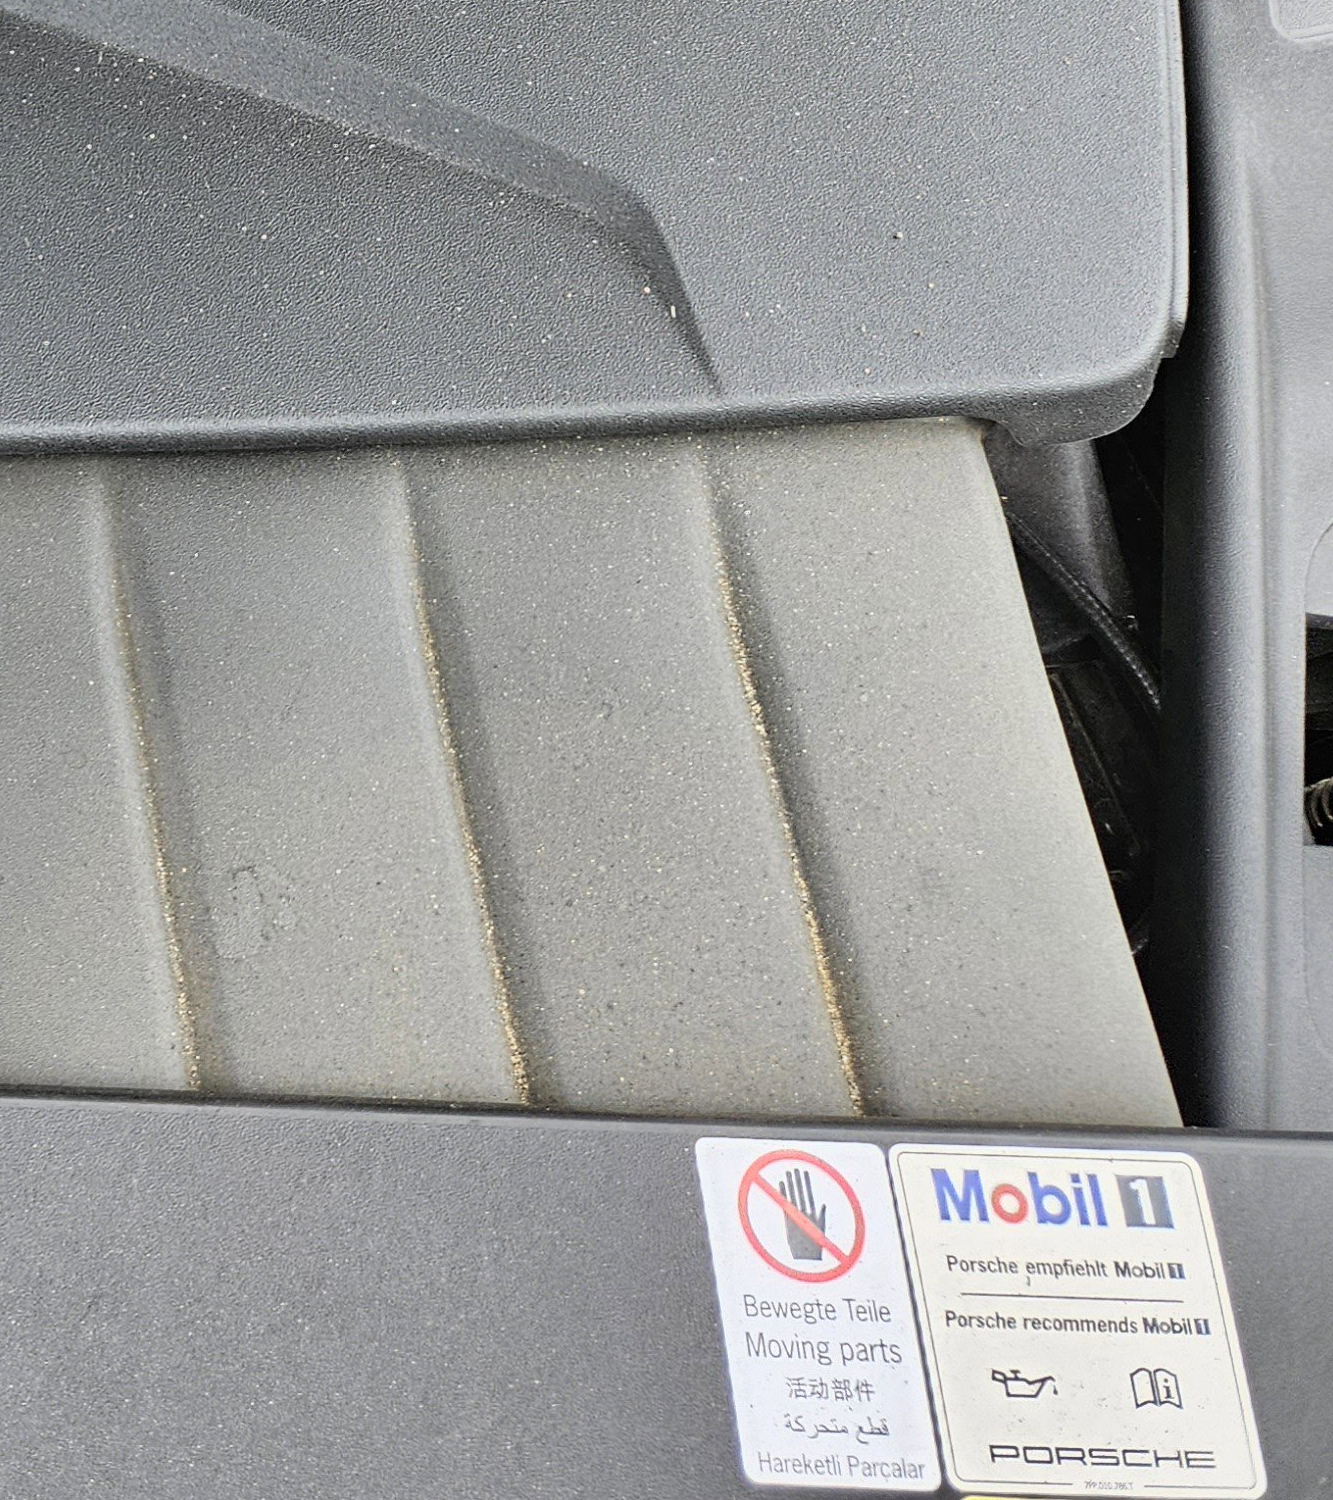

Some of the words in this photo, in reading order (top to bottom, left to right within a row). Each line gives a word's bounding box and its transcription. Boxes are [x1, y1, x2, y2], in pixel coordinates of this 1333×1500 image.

[930, 1168, 1109, 1227] Mobil
[946, 1255, 1018, 1274] Porsche
[1026, 1259, 1108, 1282] empfiehlt
[743, 1294, 837, 1325] Bewegte
[842, 1298, 891, 1323] Teile
[945, 1310, 1017, 1330] Porsche
[1023, 1314, 1138, 1334] recommends
[745, 1331, 832, 1366] Moving
[839, 1339, 902, 1366] parts
[786, 1376, 876, 1402] 活动部件
[784, 1413, 849, 1439] متحركة
[856, 1416, 890, 1444] قطع
[757, 1452, 842, 1476] Hareketli
[846, 1455, 926, 1483] Parçalar
[989, 1444, 1216, 1468] PORSCHE
